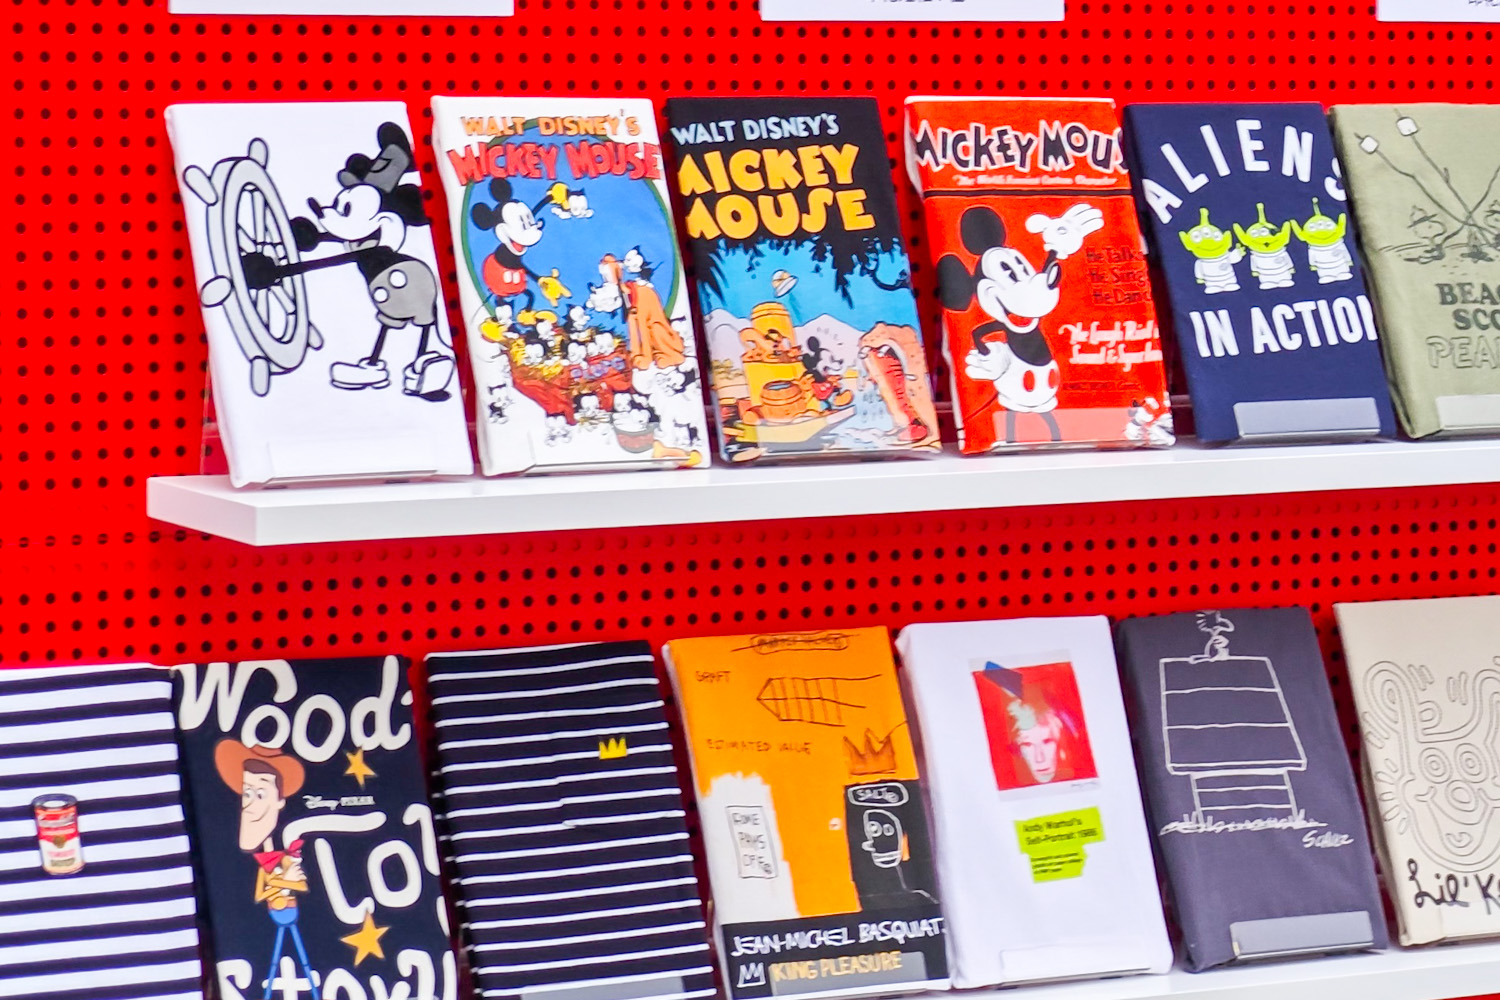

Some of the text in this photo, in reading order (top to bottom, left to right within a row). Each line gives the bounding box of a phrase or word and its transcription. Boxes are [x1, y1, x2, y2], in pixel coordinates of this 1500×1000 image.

[460, 108, 641, 137] WALT DISNEY'S
[670, 113, 840, 146] WALT DISNEY'S
[913, 119, 1038, 172] MICKEY
[447, 139, 663, 186] MICKEY MOUSE
[678, 143, 859, 197] MICKEY
[685, 188, 876, 240] MOUSE
[1189, 308, 1240, 358] IN
[177, 655, 413, 763] Wood
[730, 927, 855, 957] JEAN-MICHEL
[772, 950, 903, 982] KING PLEASURE
